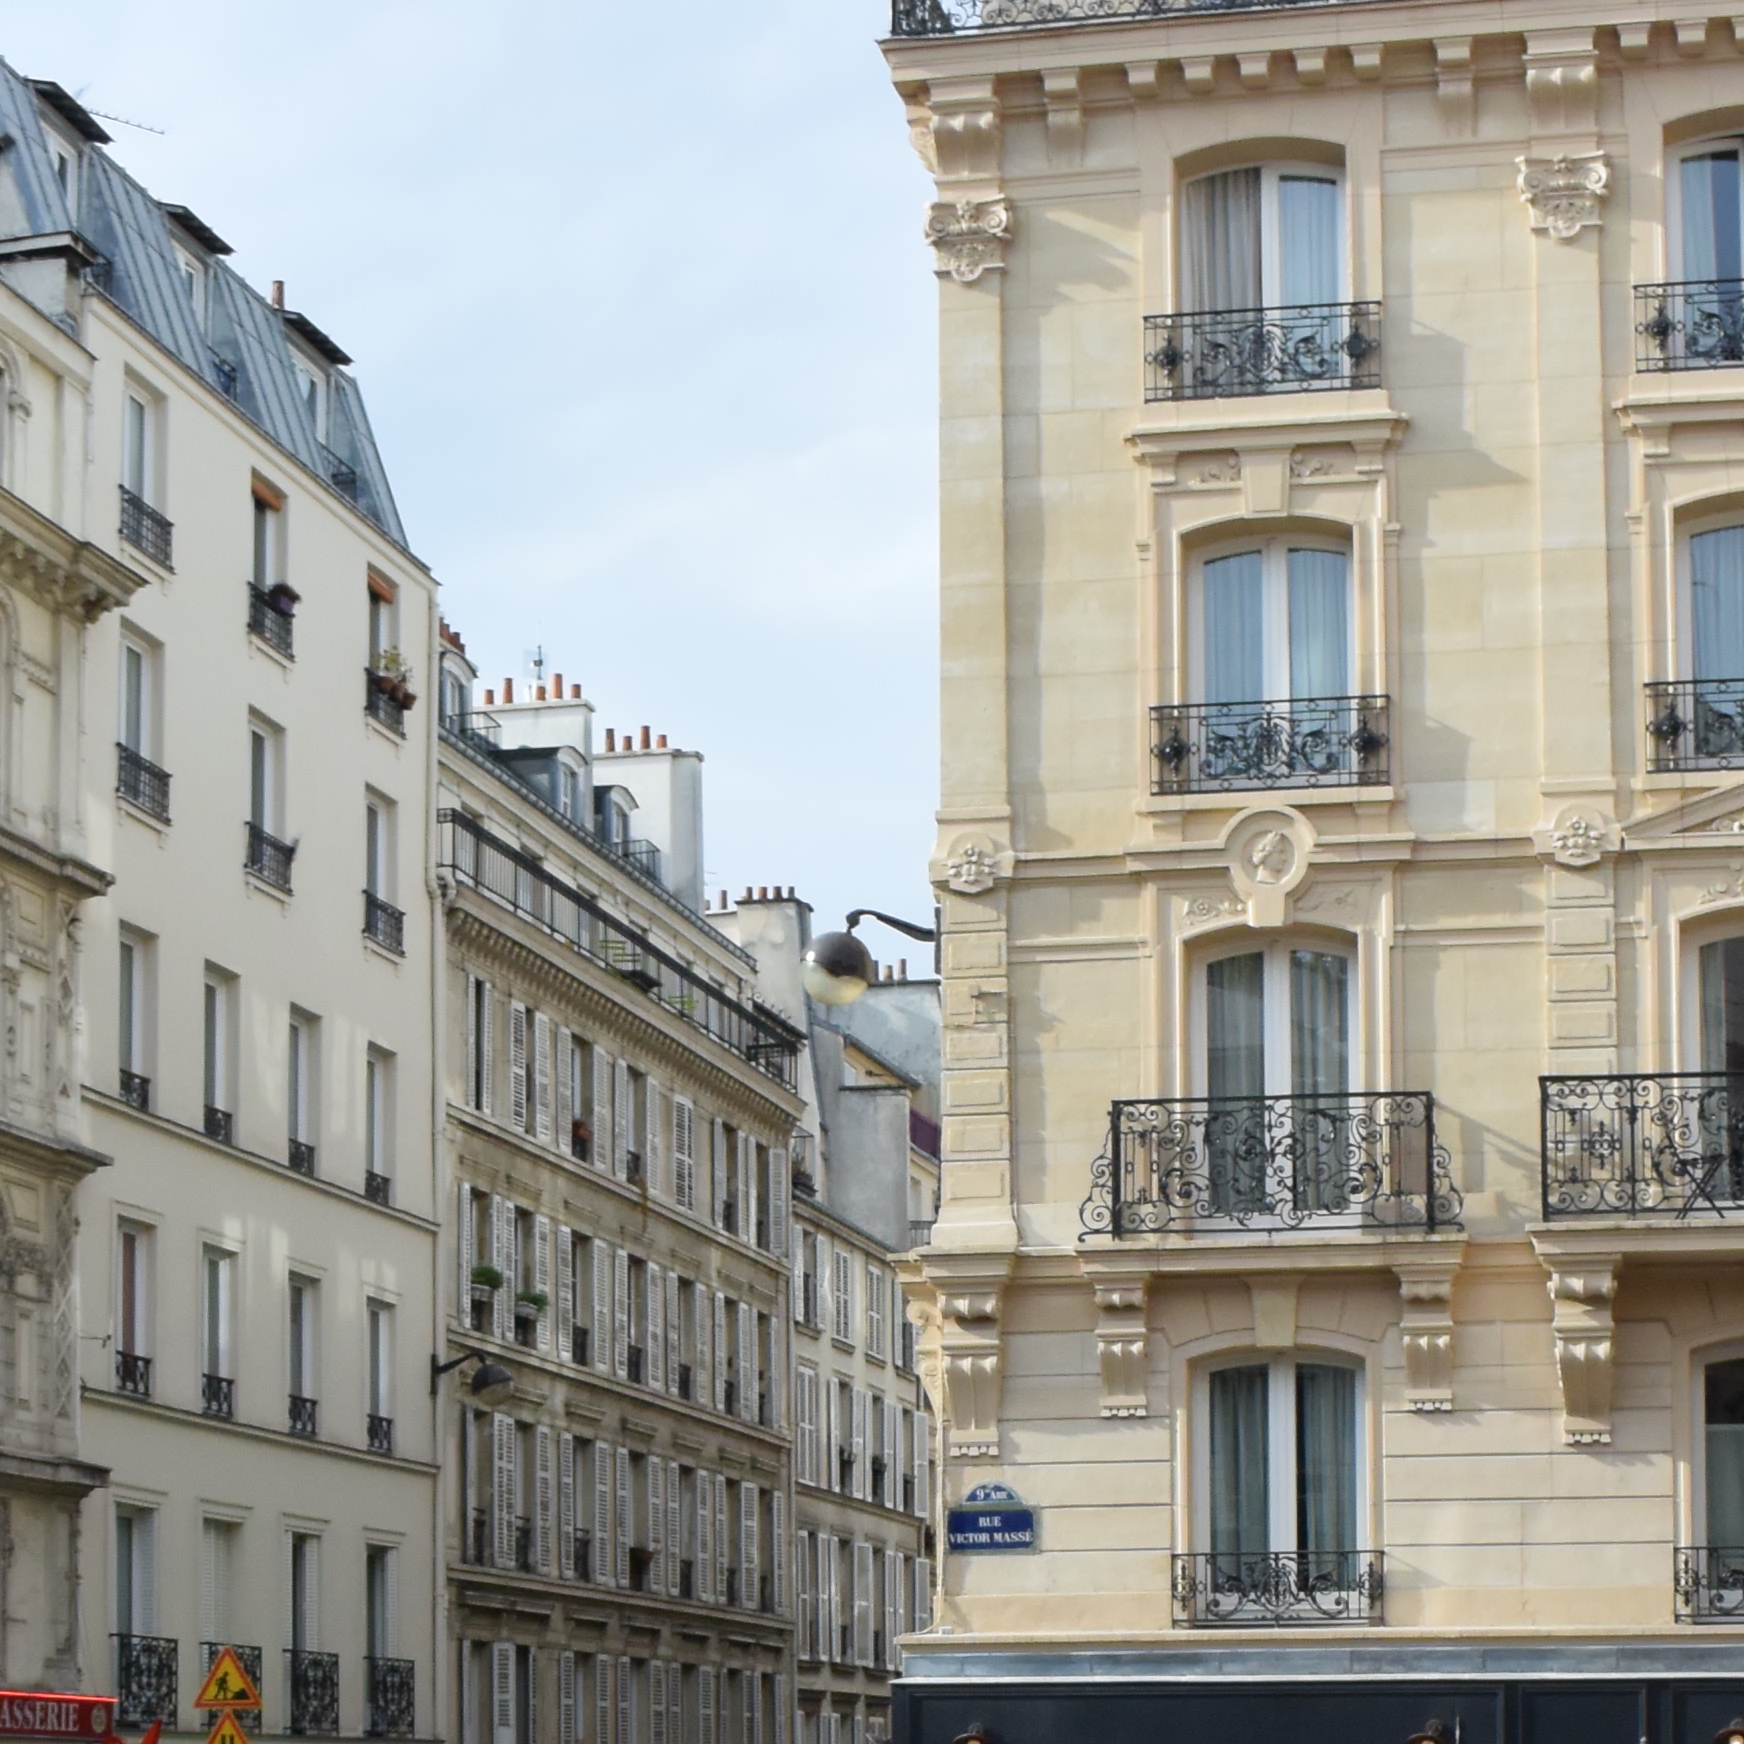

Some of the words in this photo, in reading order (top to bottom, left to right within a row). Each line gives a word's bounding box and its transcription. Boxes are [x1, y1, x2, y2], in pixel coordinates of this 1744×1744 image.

[978, 1516, 1002, 1527] RUE
[949, 1532, 990, 1544] VICTOR
[993, 1529, 1034, 1543] MASSÉ
